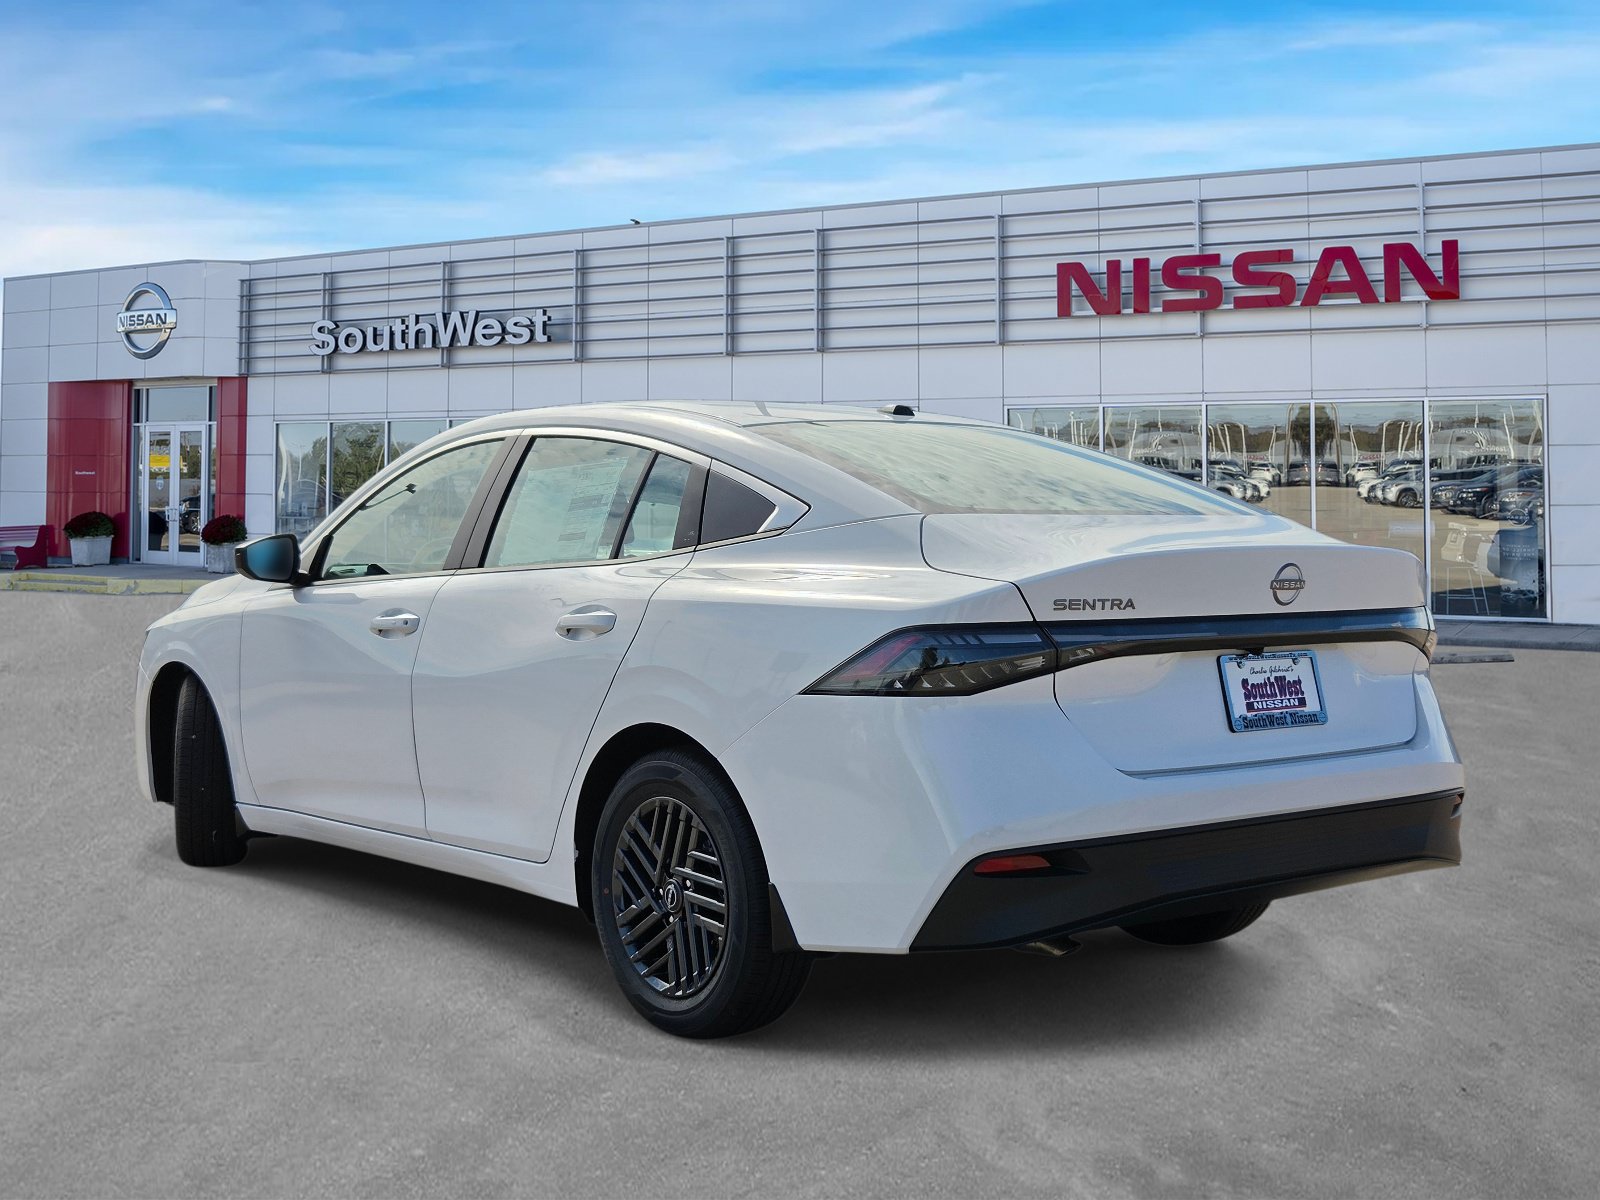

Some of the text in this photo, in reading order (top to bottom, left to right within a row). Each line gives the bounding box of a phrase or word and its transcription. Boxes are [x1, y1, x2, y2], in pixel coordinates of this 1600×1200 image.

[1056, 239, 1460, 317] NISSAN
[119, 312, 167, 328] NISSAN
[309, 308, 551, 356] SouthWest
[1272, 580, 1305, 589] NISSAN
[1053, 598, 1136, 611] SENTRA
[1241, 675, 1305, 701] SouthWest
[1253, 699, 1299, 709] NISSAN
[1242, 712, 1319, 729] SouthWest Nissan
